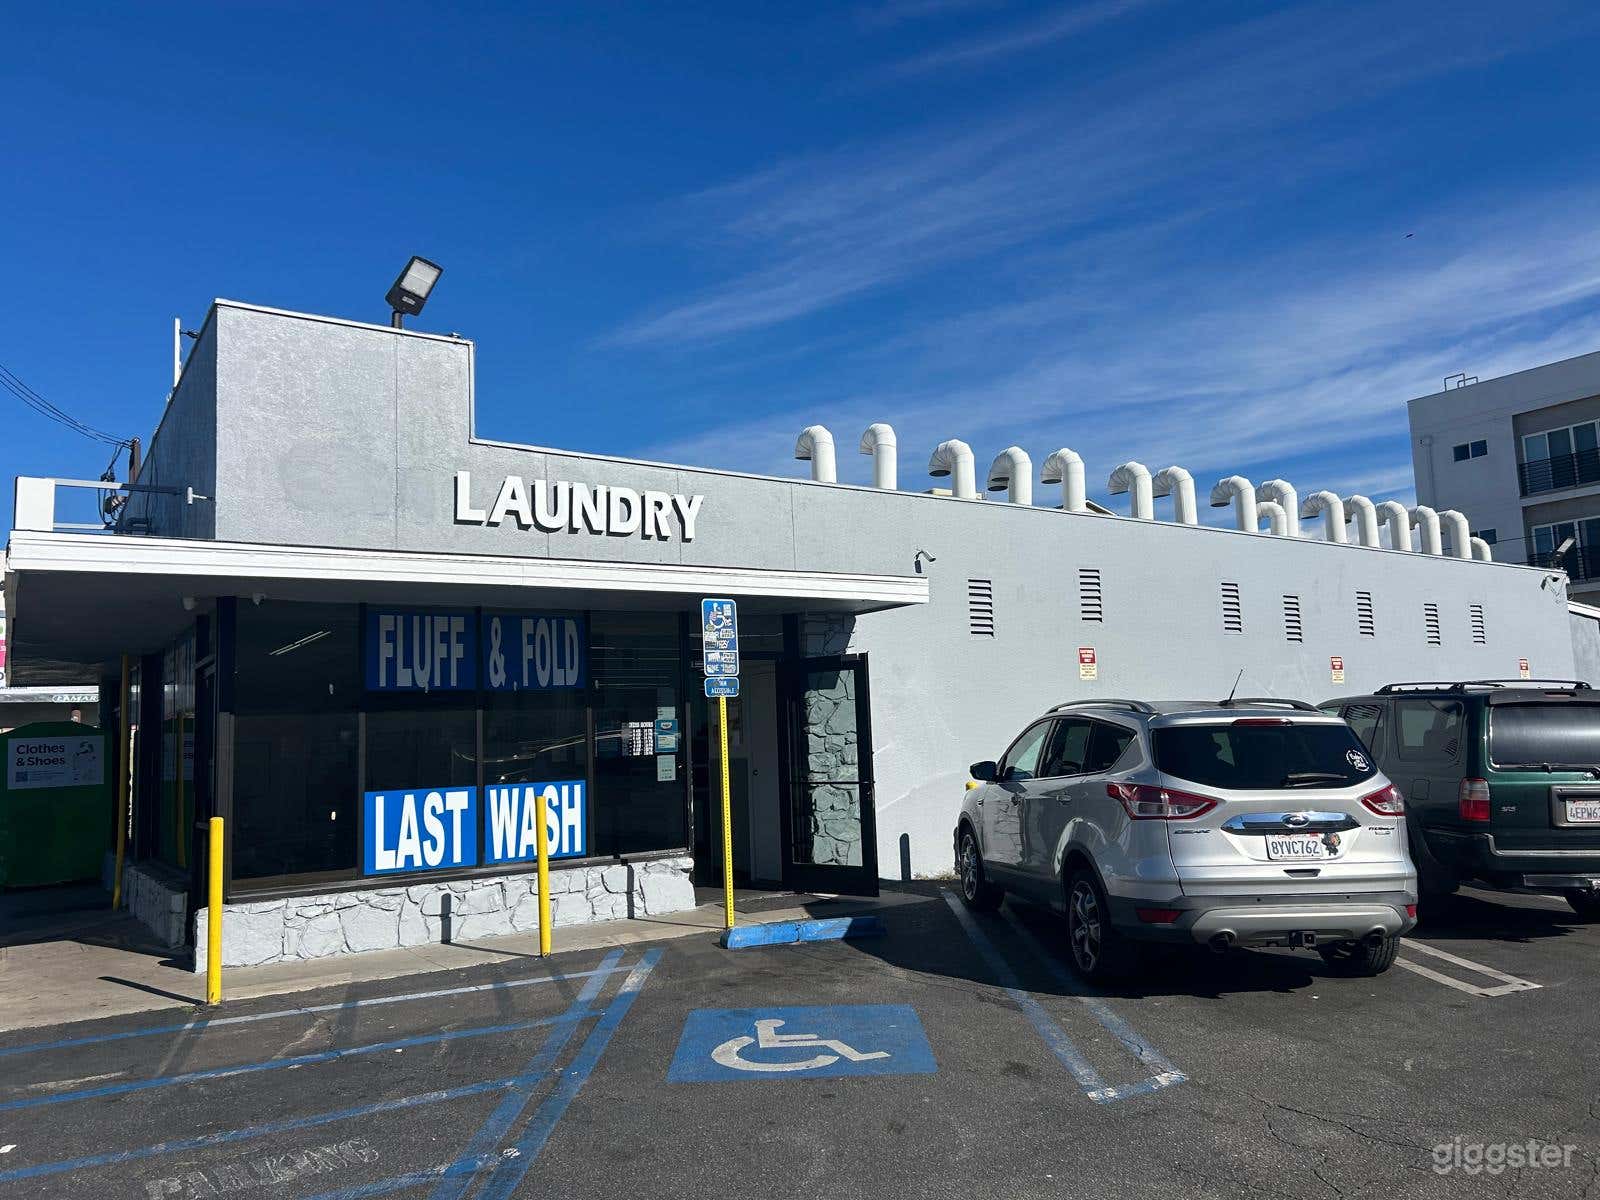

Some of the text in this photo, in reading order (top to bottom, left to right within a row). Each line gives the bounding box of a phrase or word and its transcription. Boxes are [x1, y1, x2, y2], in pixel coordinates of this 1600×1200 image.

[455, 471, 704, 542] LAUNDRY
[379, 615, 579, 688] FLUFF & FOLD
[16, 743, 65, 754] Clothes
[16, 756, 65, 767] & Shoes
[375, 784, 582, 871] LAST WASH
[1271, 840, 1320, 855] 8YVC762
